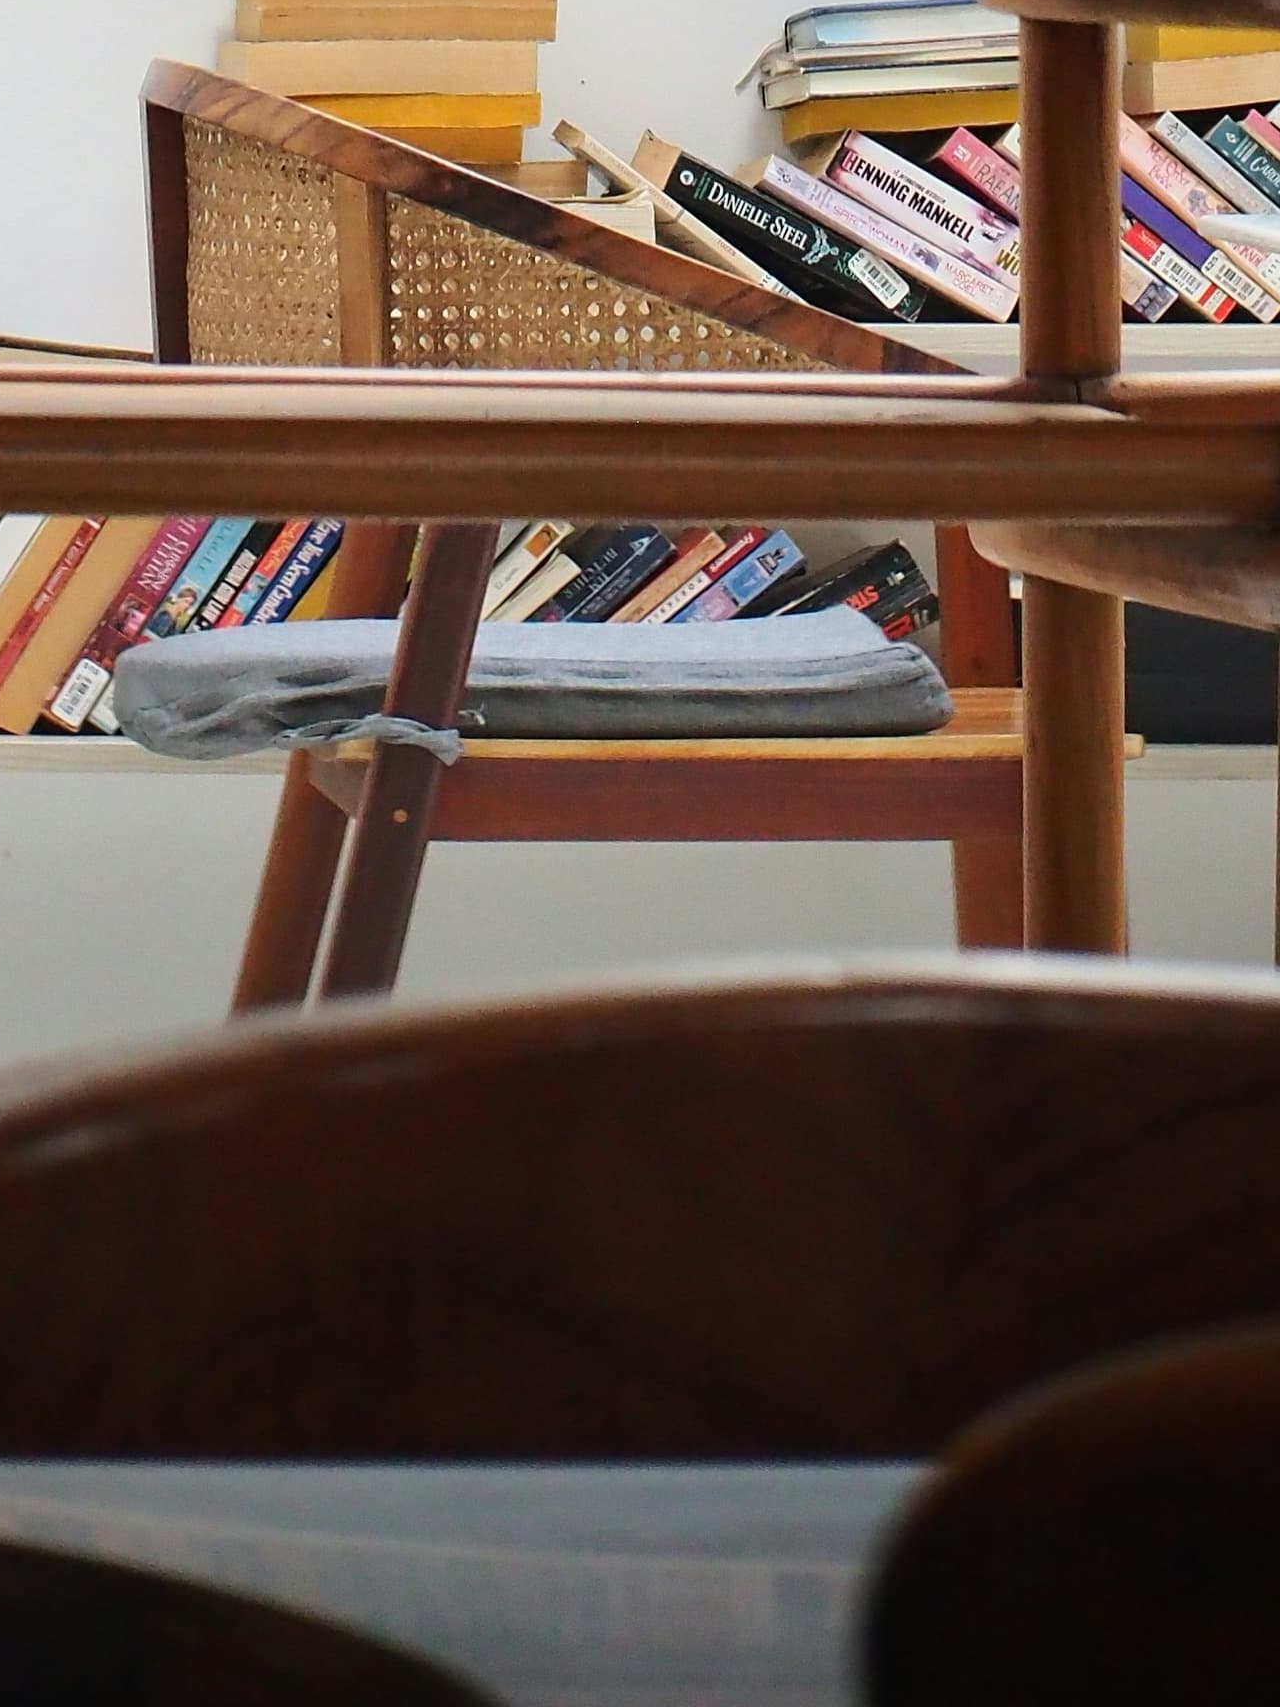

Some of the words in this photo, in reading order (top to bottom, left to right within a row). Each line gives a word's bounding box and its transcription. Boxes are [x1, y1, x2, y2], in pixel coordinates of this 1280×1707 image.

[707, 181, 771, 231] DANIELLE
[768, 215, 809, 252] STEEL
[841, 150, 909, 205] HENNING
[908, 192, 977, 243] MANKELL
[944, 260, 995, 296] MARGARET
